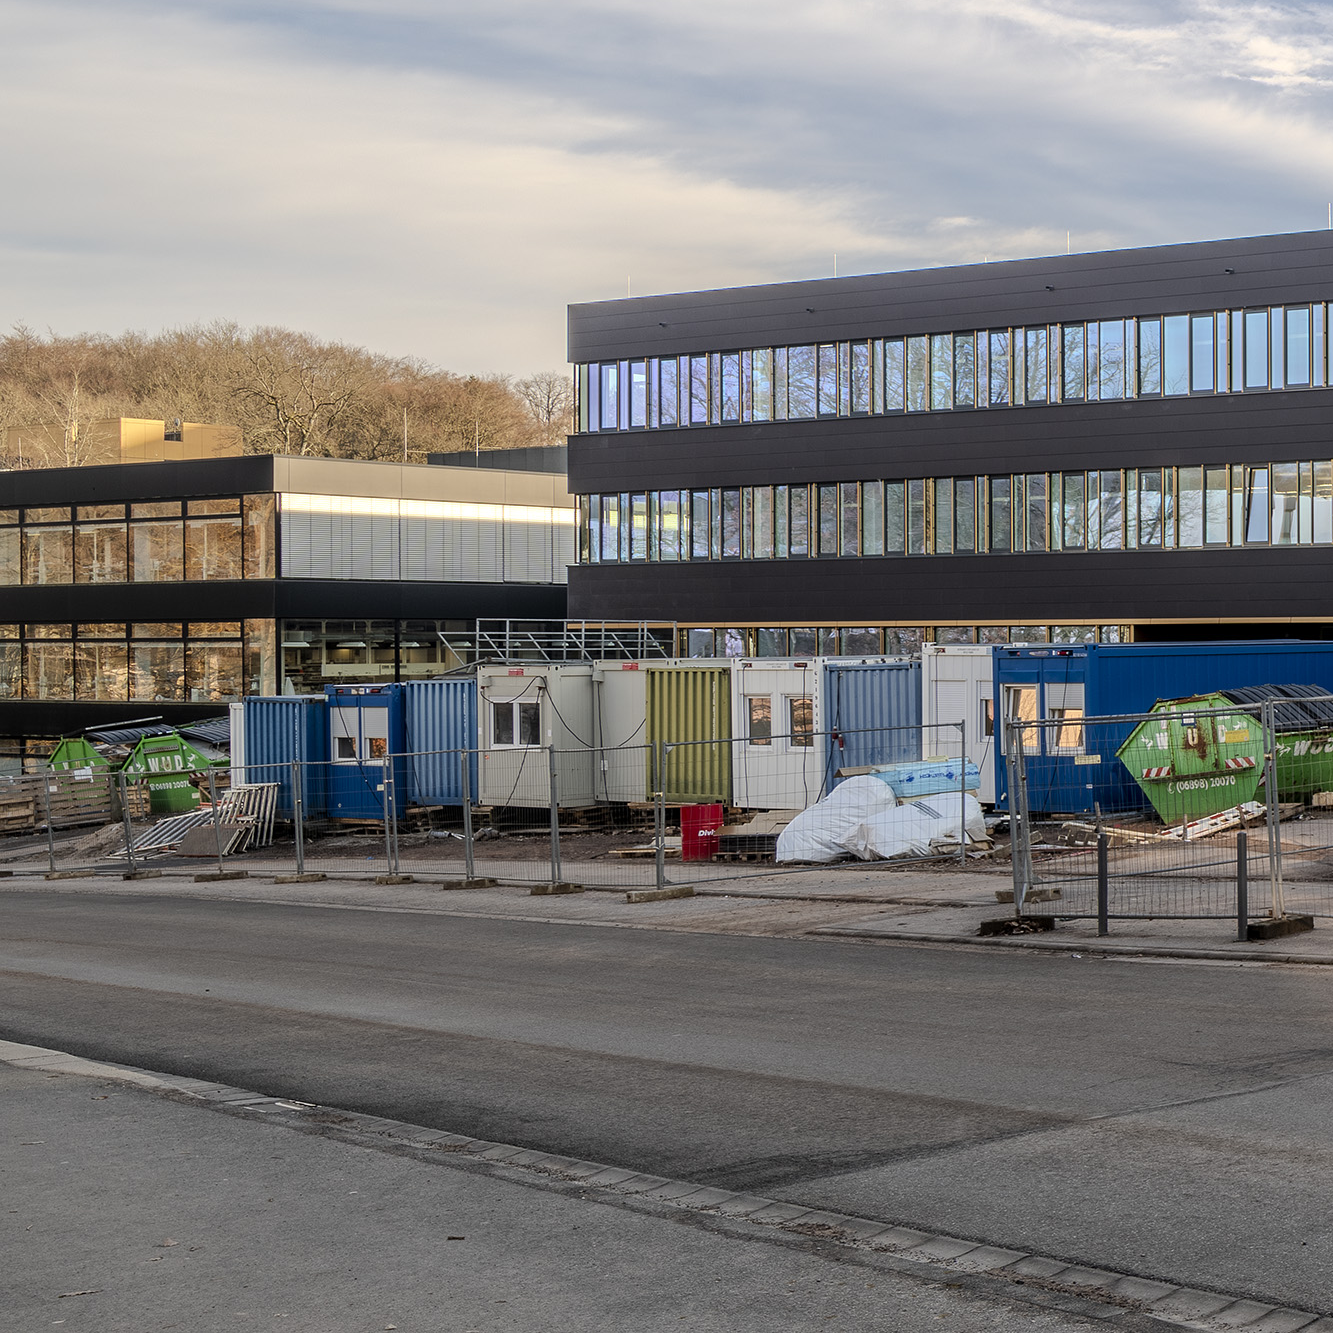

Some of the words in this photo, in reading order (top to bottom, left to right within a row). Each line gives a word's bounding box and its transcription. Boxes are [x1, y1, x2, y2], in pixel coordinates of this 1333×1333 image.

[1176, 778, 1208, 794] (06898)
[1210, 775, 1236, 787] 20070
[698, 829, 716, 837] Divi
